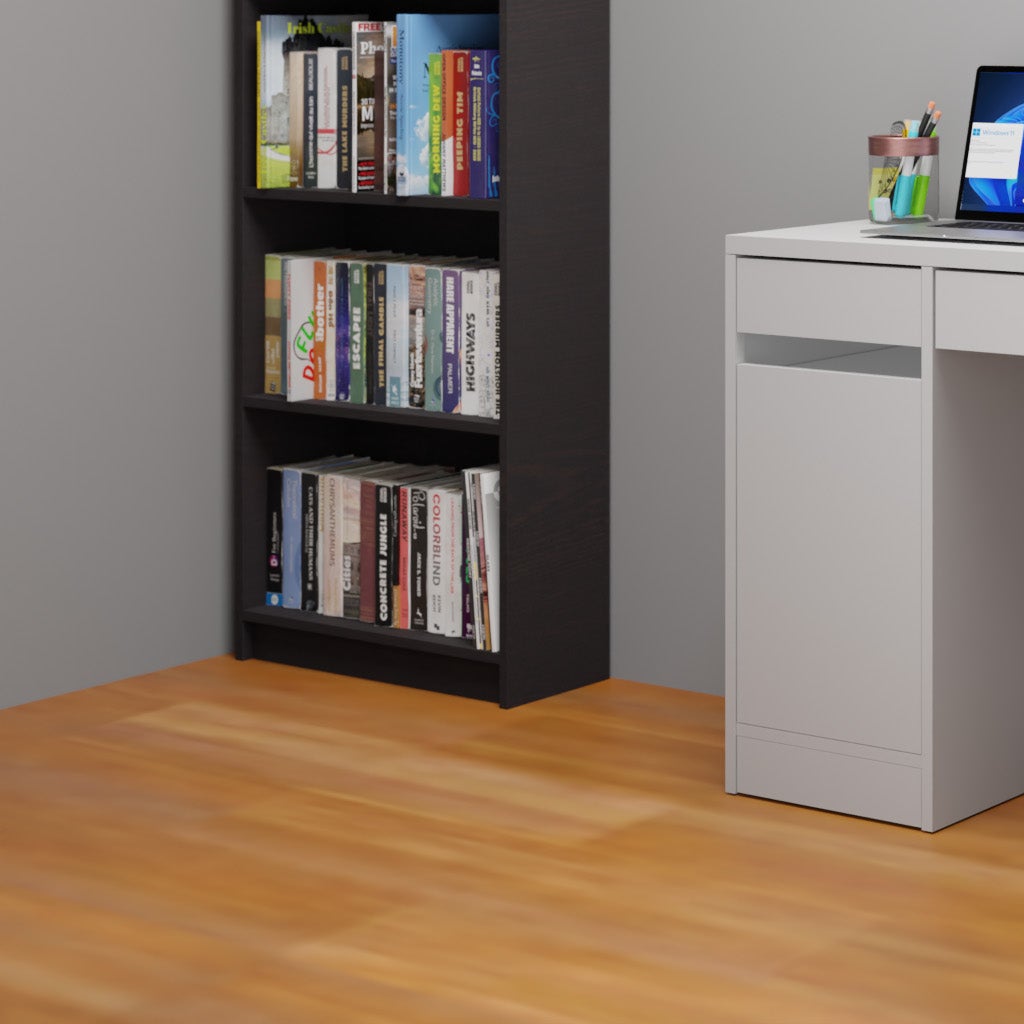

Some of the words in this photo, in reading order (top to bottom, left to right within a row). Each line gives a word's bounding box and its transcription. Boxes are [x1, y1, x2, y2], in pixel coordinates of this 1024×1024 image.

[287, 21, 316, 35] Irish
[358, 23, 381, 31] FREE
[433, 84, 441, 112] DEW
[456, 91, 464, 114] TIM
[433, 115, 441, 174] MORNING
[456, 118, 464, 170] PEEPING
[445, 276, 455, 303] HARE
[352, 306, 361, 370] ESCAPEE
[445, 303, 455, 354] APPARENT
[466, 313, 476, 392] HIGHWAYS
[379, 513, 388, 558] JUNGLE
[432, 494, 441, 586] COLORBLIND
[342, 555, 352, 592] Cities
[379, 560, 388, 622] CONCRETE
